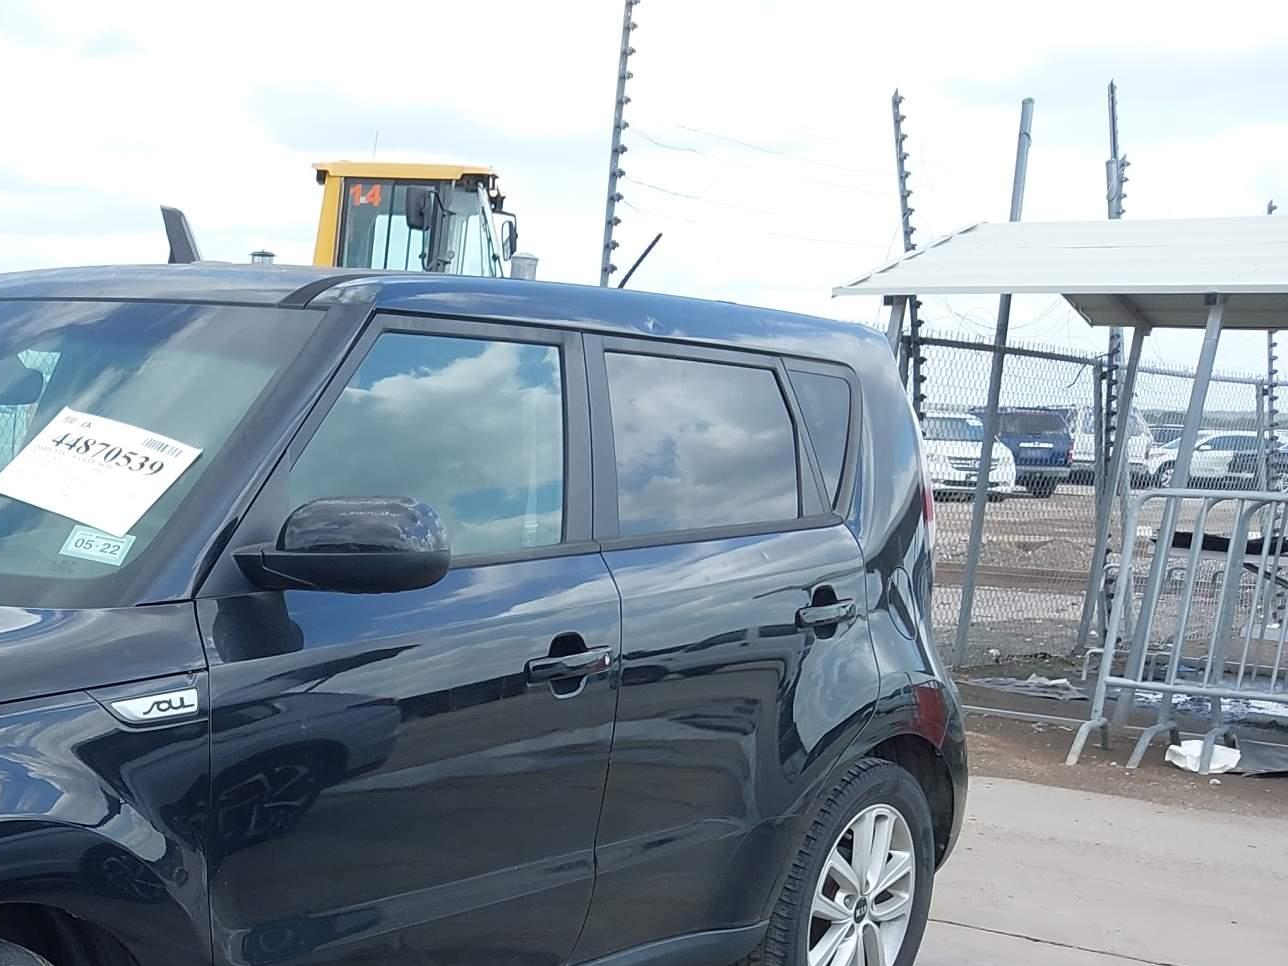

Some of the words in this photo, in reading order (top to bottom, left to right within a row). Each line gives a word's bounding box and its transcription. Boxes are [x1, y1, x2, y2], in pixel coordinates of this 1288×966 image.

[349, 183, 383, 207] 14
[51, 432, 165, 476] 44870539
[142, 696, 195, 716] SOUL
